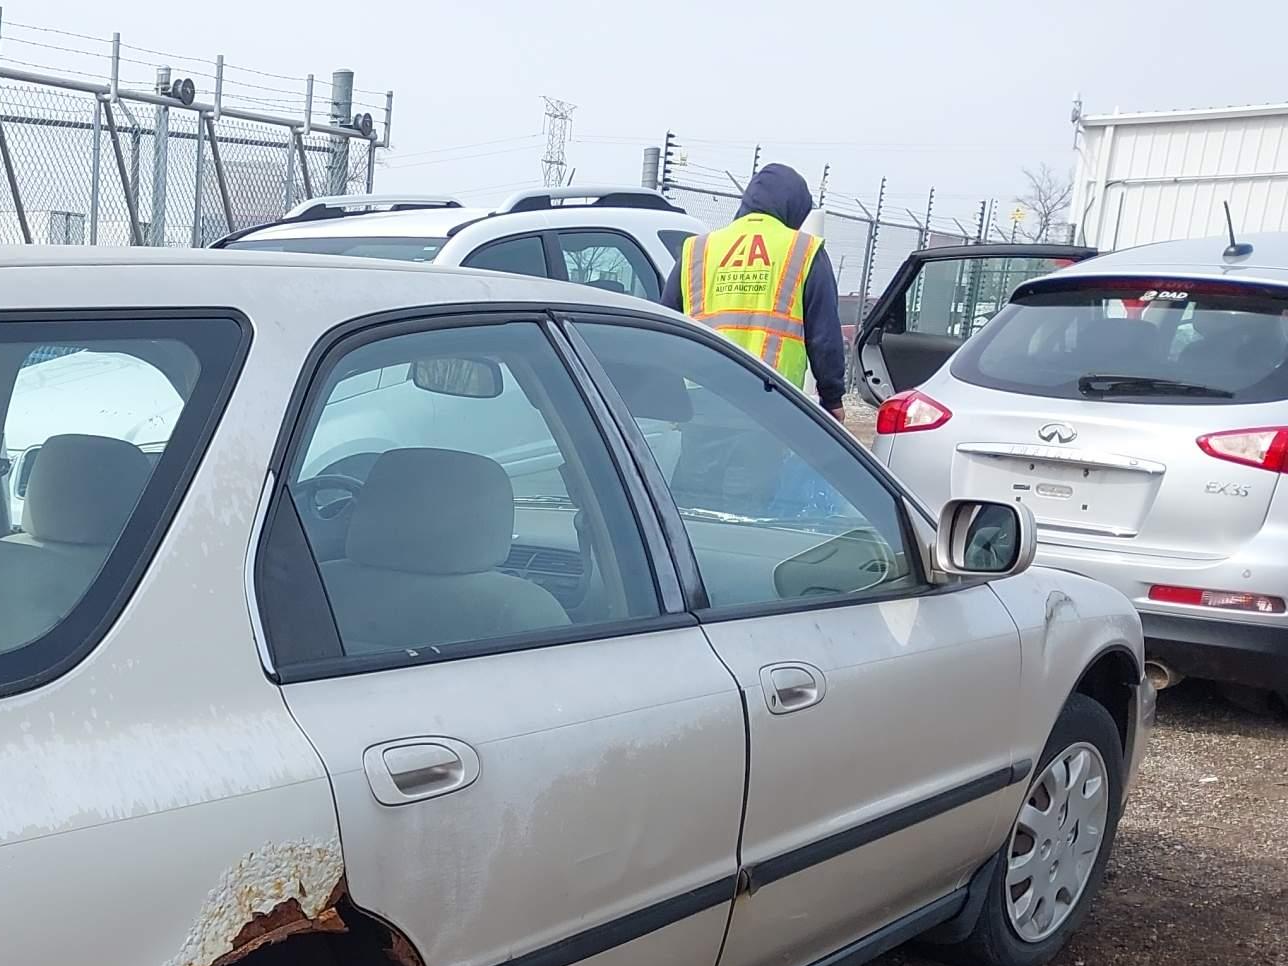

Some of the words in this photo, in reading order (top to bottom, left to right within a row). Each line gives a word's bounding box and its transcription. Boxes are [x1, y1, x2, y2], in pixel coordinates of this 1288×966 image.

[716, 272, 769, 282] INSURANCE
[716, 284, 732, 293] AUTO
[734, 284, 767, 293] AUCTIONS
[1158, 291, 1188, 299] DAD
[1204, 481, 1251, 497] EX35
